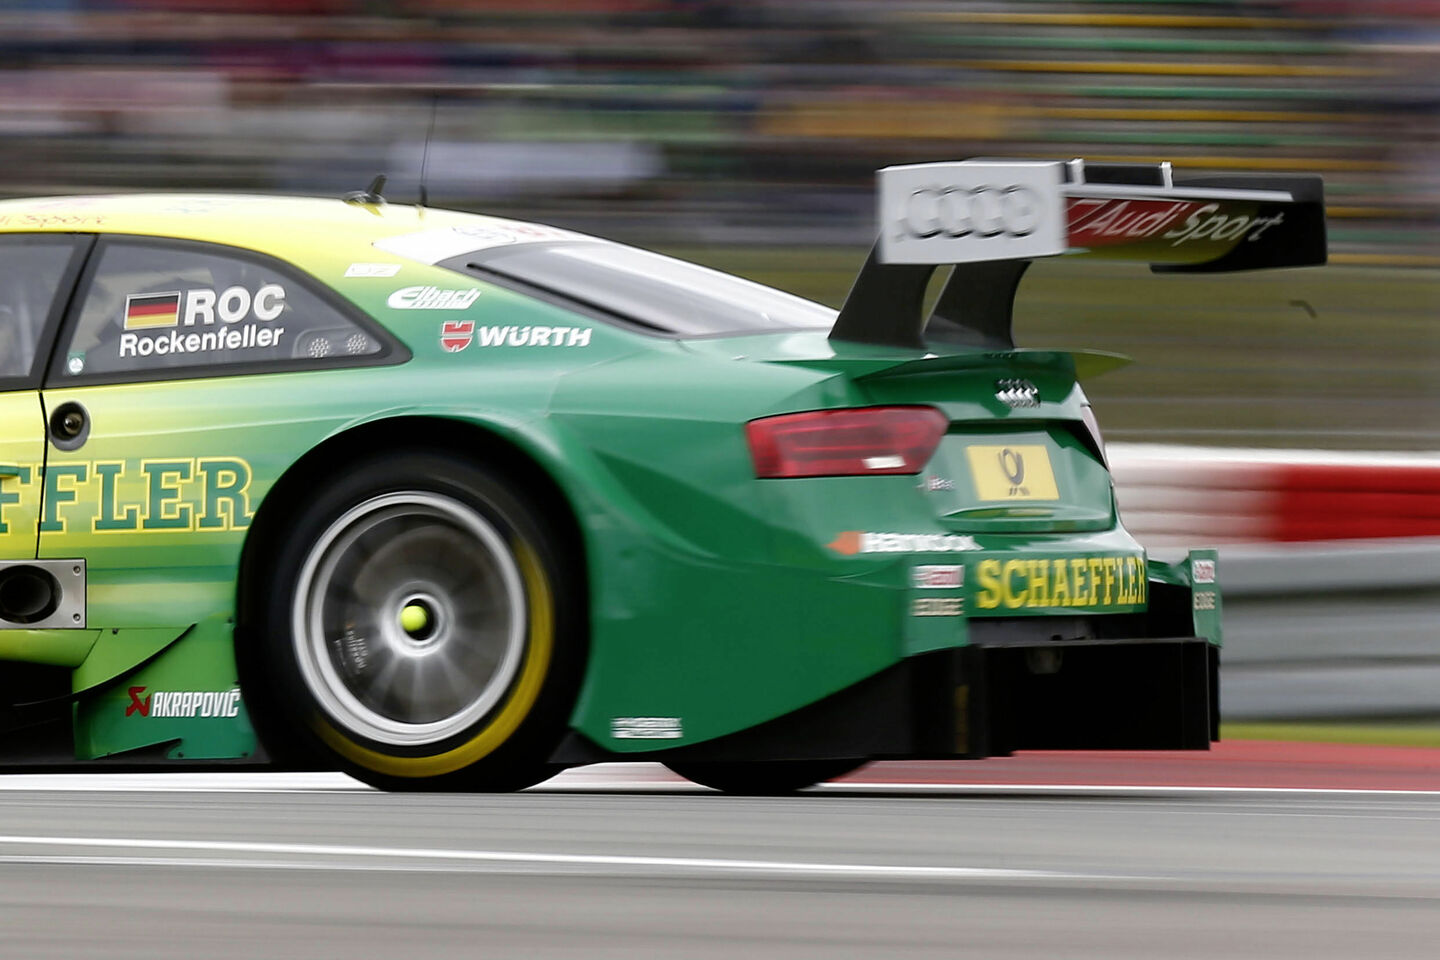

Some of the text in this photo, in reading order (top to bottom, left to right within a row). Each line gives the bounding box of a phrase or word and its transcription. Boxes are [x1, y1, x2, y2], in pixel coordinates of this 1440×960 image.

[1072, 199, 1285, 247] Audi Sport
[184, 284, 286, 327] ROC
[119, 324, 285, 358] Rockenfeller
[478, 325, 593, 347] WÜRTH
[975, 556, 1146, 609] SCHAEFFLER
